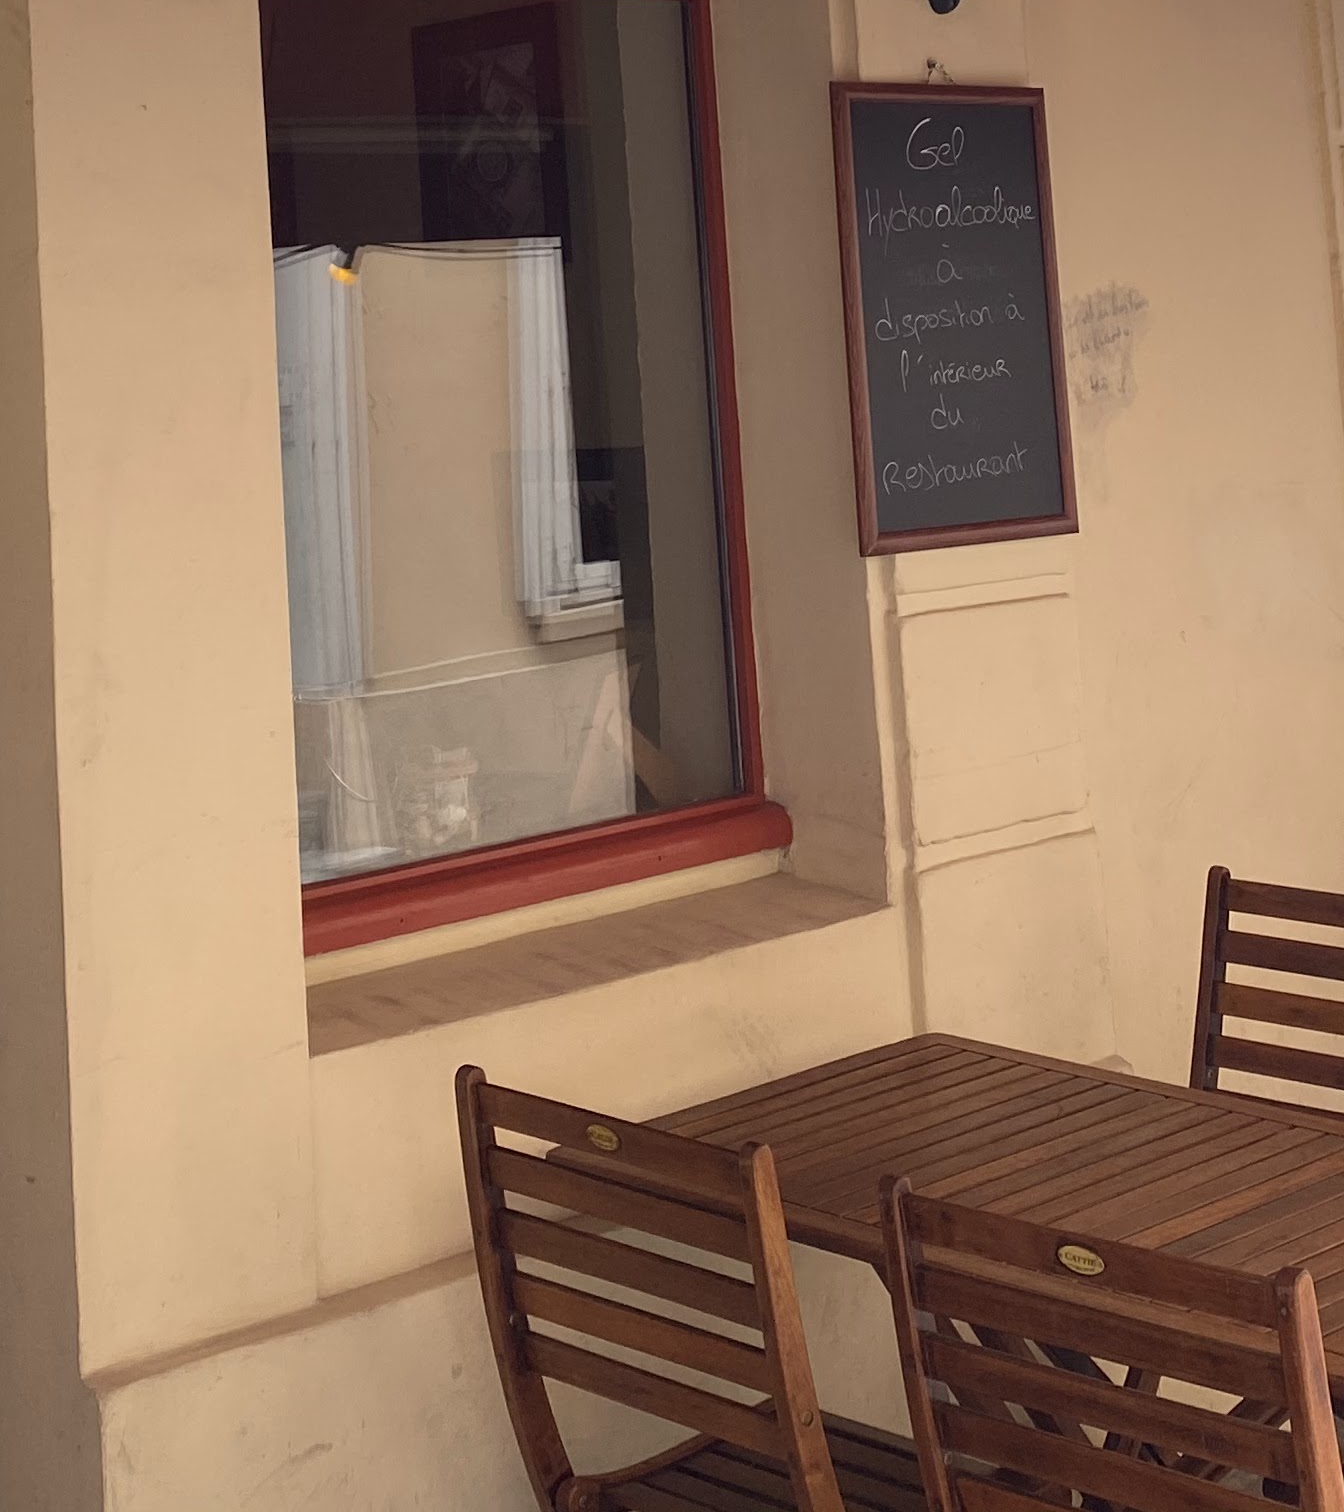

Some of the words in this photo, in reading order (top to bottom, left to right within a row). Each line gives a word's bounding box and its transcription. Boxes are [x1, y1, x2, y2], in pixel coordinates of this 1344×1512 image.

[906, 118, 965, 170] Gel
[875, 297, 994, 344] disposition
[1006, 292, 1025, 321] à
[931, 393, 964, 430] du
